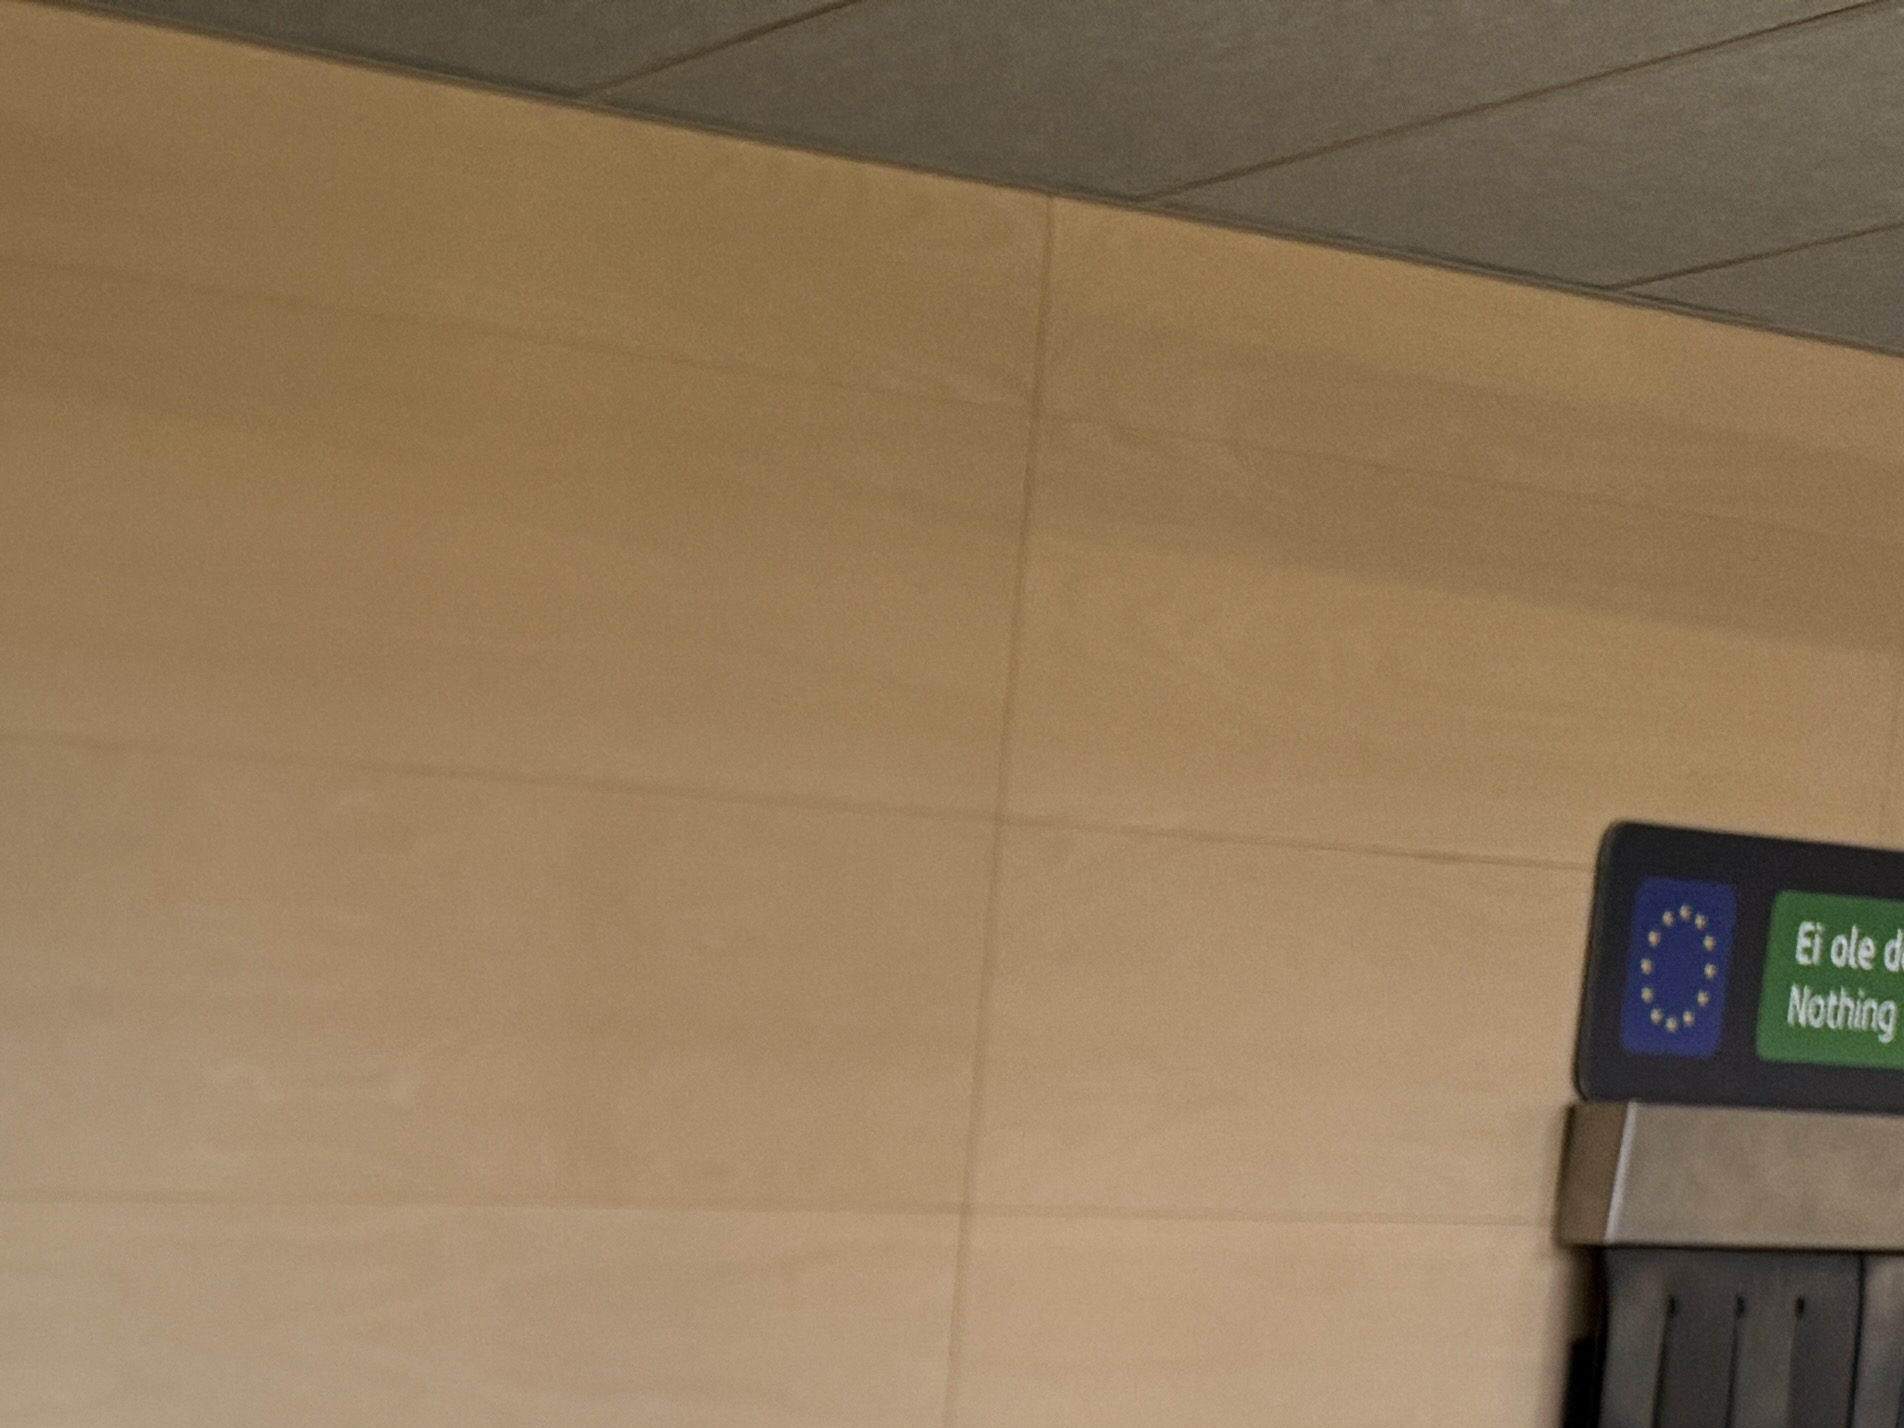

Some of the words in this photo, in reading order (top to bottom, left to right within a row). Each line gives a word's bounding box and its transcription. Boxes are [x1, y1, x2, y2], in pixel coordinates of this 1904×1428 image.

[1796, 921, 1823, 965] Ei
[1830, 924, 1876, 970] ole
[1787, 984, 1897, 1043] Nothing
